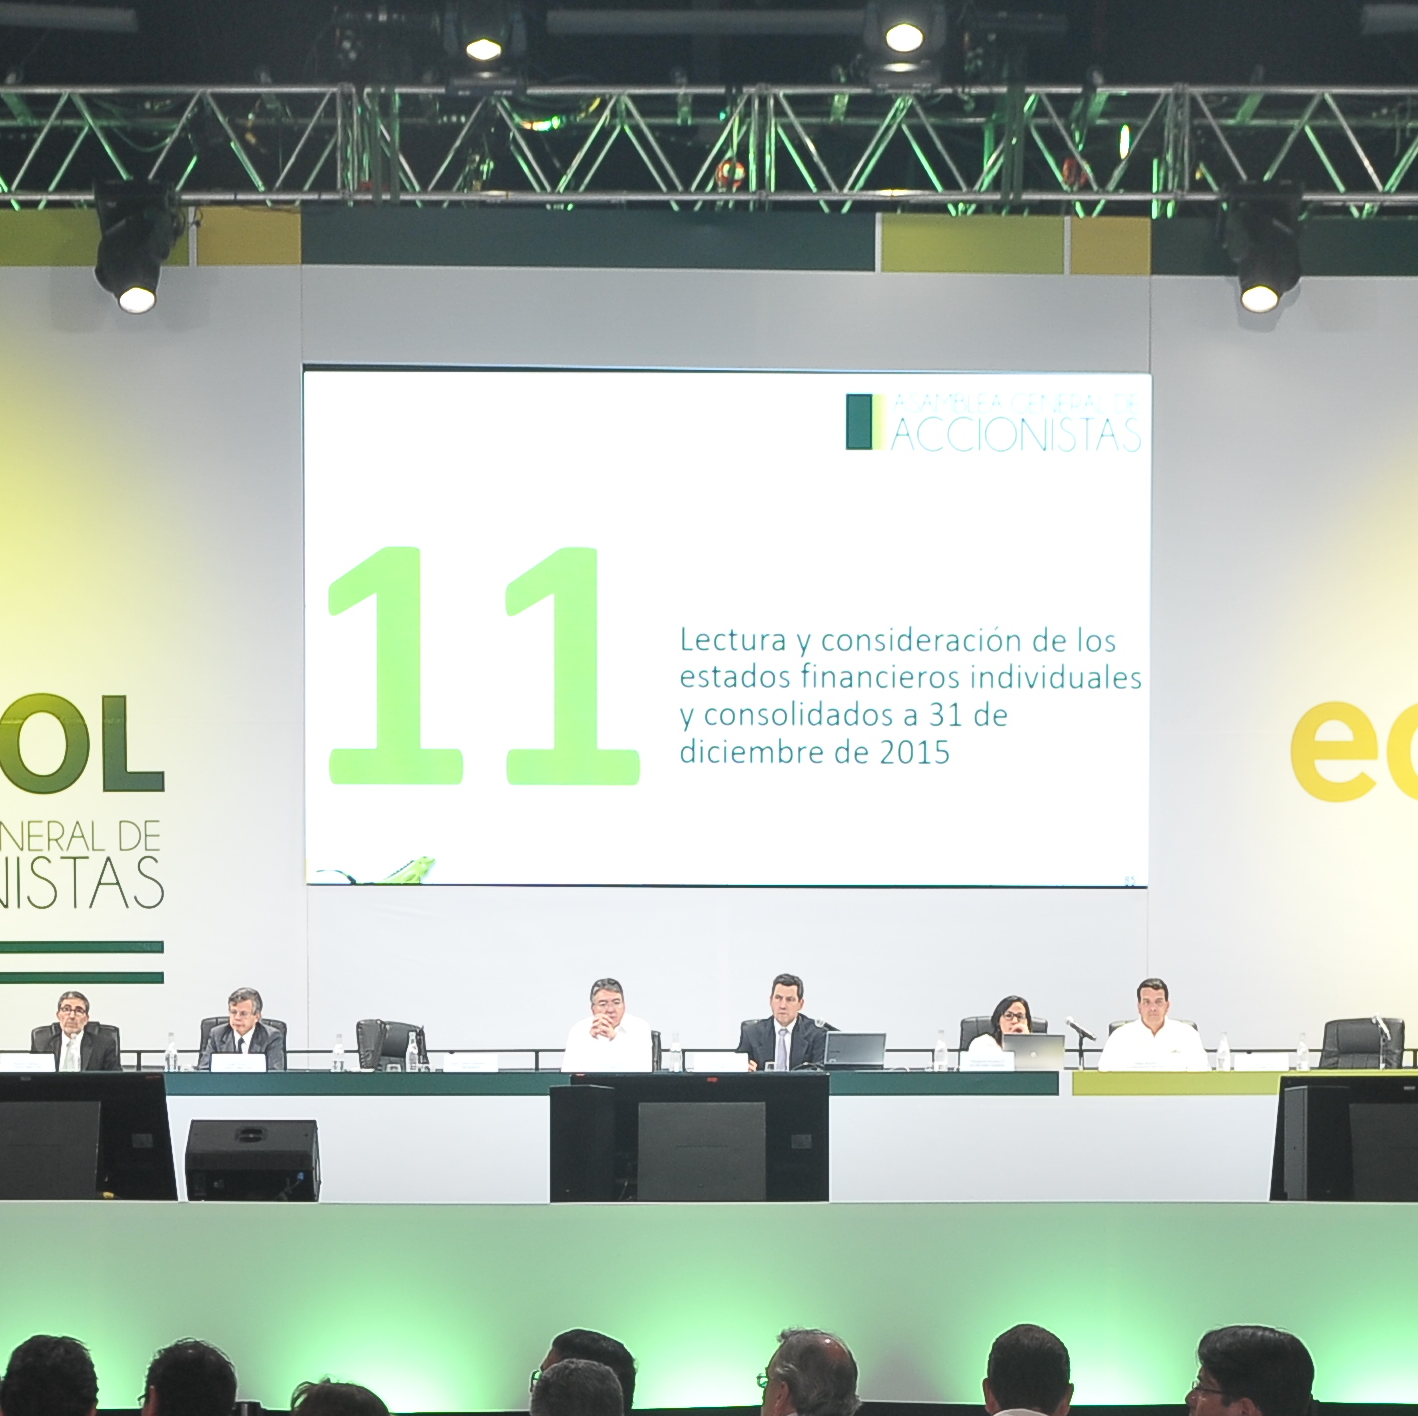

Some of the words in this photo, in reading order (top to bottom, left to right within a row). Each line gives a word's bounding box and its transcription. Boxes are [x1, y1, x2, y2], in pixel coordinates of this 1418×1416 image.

[893, 392, 1003, 414] ASAMBLEA
[1011, 392, 1105, 414] GENERAL
[1114, 393, 1139, 414] DE
[890, 416, 1142, 452] ACCIONISTAS
[681, 627, 786, 653] Lectura
[796, 634, 812, 658] y
[821, 626, 1021, 653] consideración
[1032, 627, 1067, 653] de
[1078, 627, 1116, 653] los
[328, 546, 642, 786] 11
[681, 663, 791, 690] estados
[800, 662, 960, 690] financieros
[971, 663, 1142, 690] individuales
[680, 708, 695, 732] y
[704, 700, 893, 727] consolidados
[903, 709, 918, 727] a
[929, 702, 962, 727] 31
[974, 701, 1008, 727] de
[681, 737, 824, 764] diciembre
[834, 738, 869, 765] de
[880, 740, 950, 765] 2015
[118, 820, 161, 852] DE
